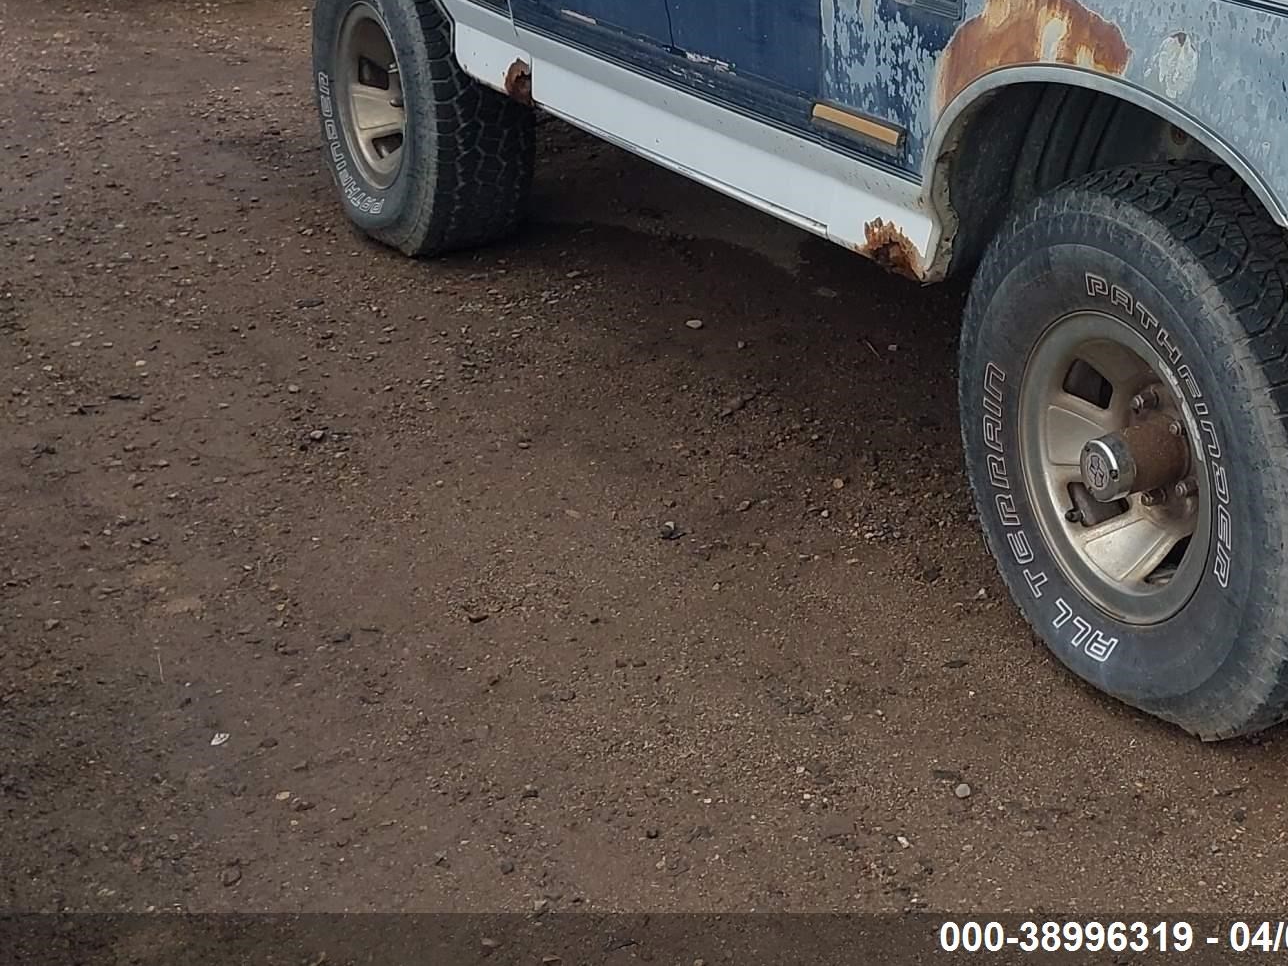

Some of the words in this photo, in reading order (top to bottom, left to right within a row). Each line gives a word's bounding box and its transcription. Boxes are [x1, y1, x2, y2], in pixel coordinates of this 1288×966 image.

[318, 71, 384, 215] PATHFINDER
[983, 362, 1049, 600] TERRAIN
[1085, 272, 1233, 588] PATHFINDER
[1051, 597, 1119, 663] ALL
